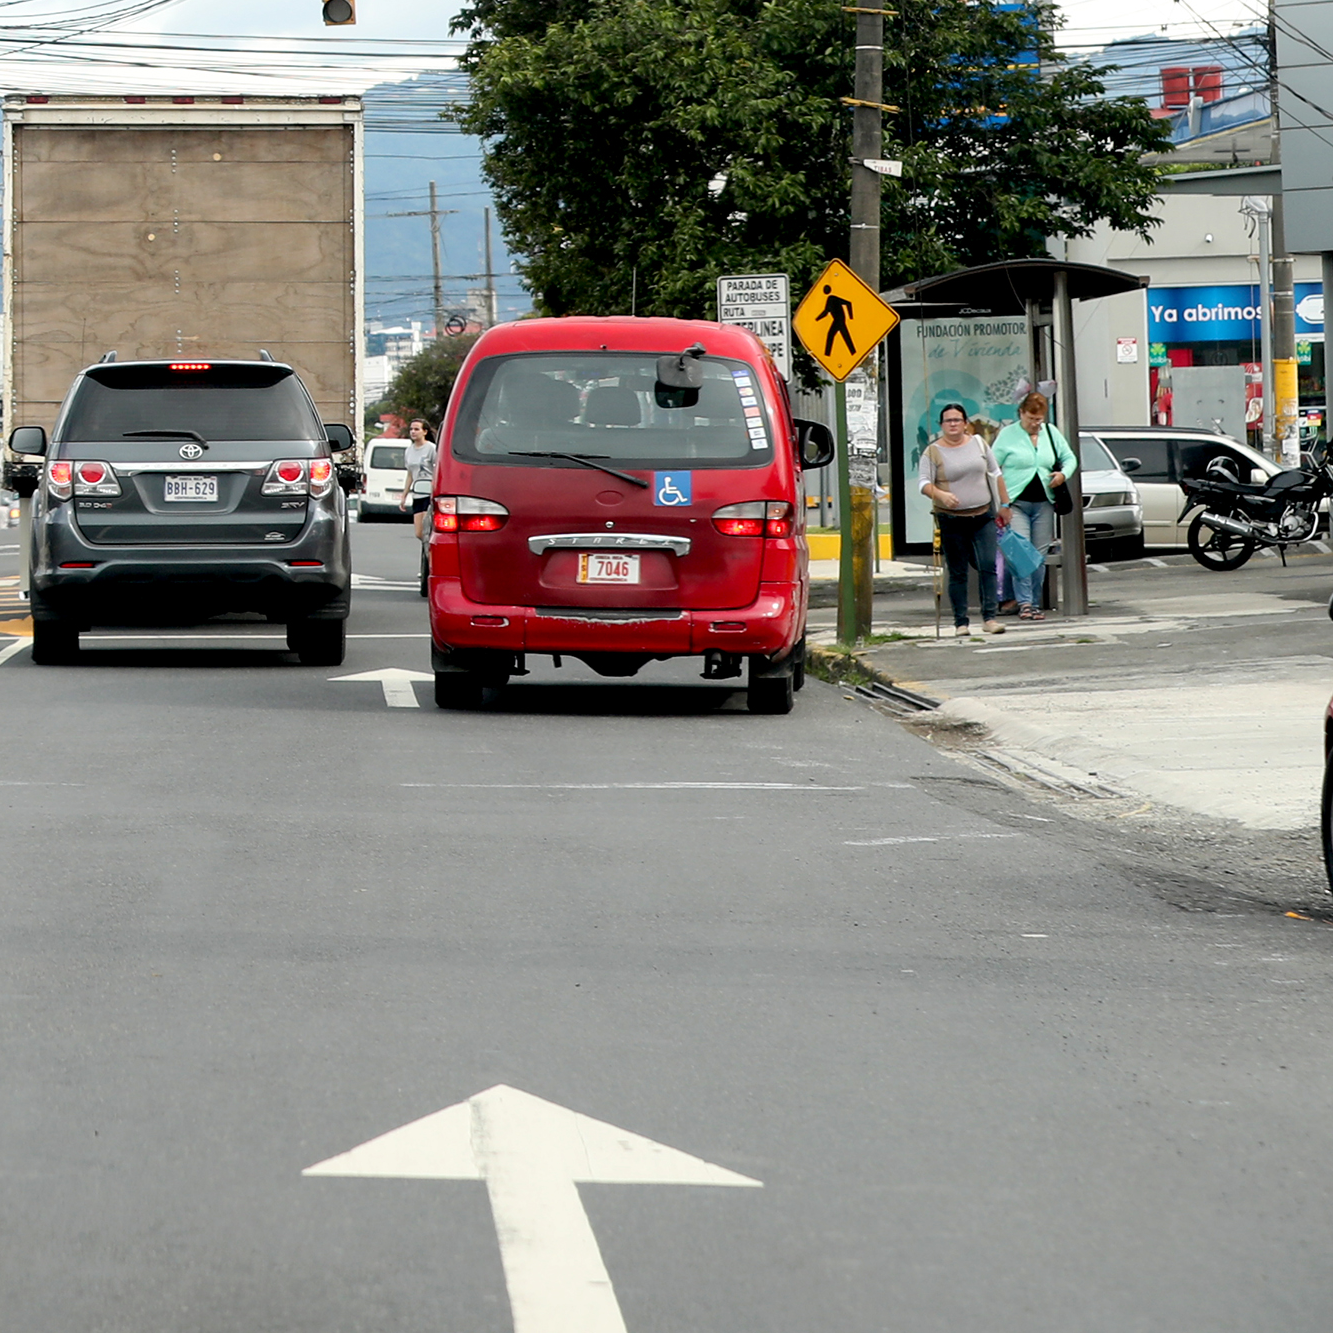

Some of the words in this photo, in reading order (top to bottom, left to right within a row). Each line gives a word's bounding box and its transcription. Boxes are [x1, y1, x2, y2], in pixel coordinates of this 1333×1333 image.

[727, 280, 763, 291] PARADA
[765, 279, 778, 290] DE
[725, 291, 781, 303] AUTOBUSES
[723, 307, 745, 318] RUTA
[1150, 305, 1178, 323] Ya
[1183, 303, 1263, 322] abrimos
[916, 322, 971, 338] FUNDACIÓN
[973, 322, 1027, 335] PROMOTOR
[167, 481, 215, 495] BBH-629
[597, 561, 629, 577] 7046
